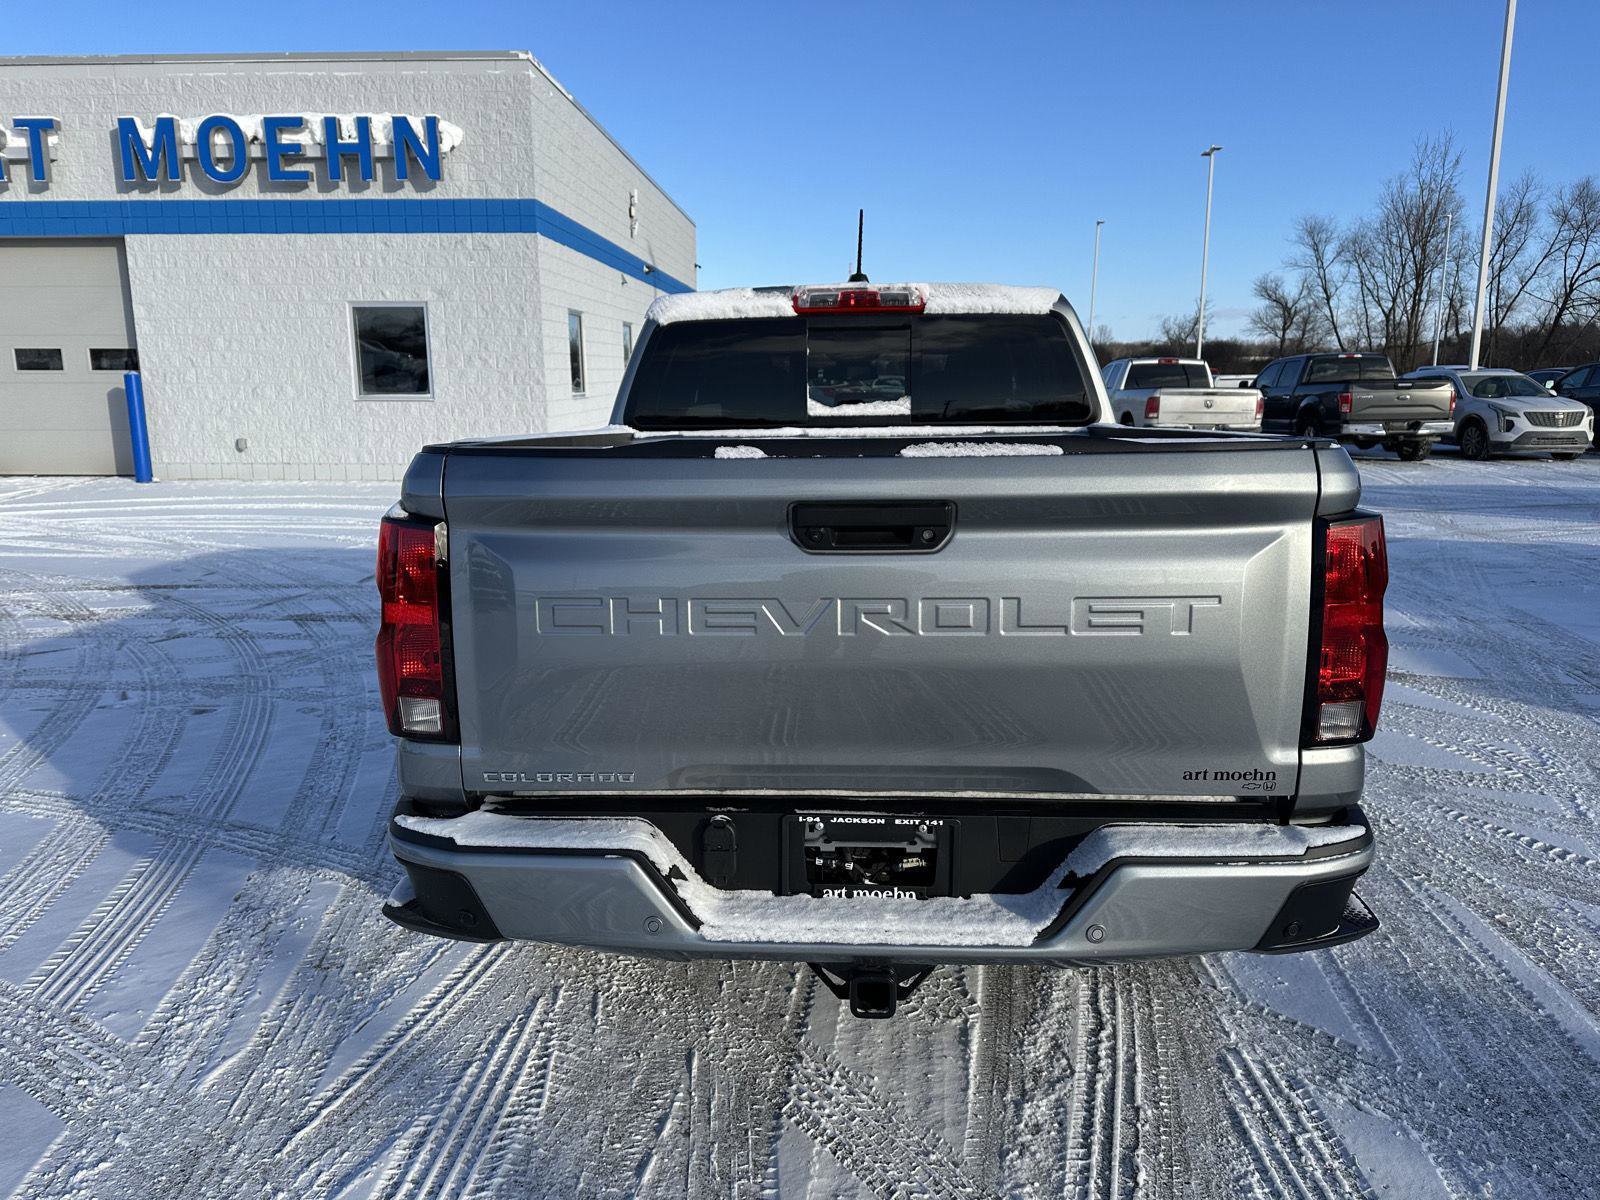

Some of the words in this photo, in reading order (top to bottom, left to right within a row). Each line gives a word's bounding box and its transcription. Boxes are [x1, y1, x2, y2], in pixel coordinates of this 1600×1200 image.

[0, 115, 61, 182] T
[117, 114, 443, 184] MOEHN
[535, 595, 1222, 637] CHEVROLET
[482, 771, 636, 783] COLORADO
[1182, 768, 1208, 781] art
[1213, 768, 1277, 781] moehn
[830, 817, 886, 825] JACKSON
[822, 886, 847, 899] art
[852, 886, 918, 900] moehn
